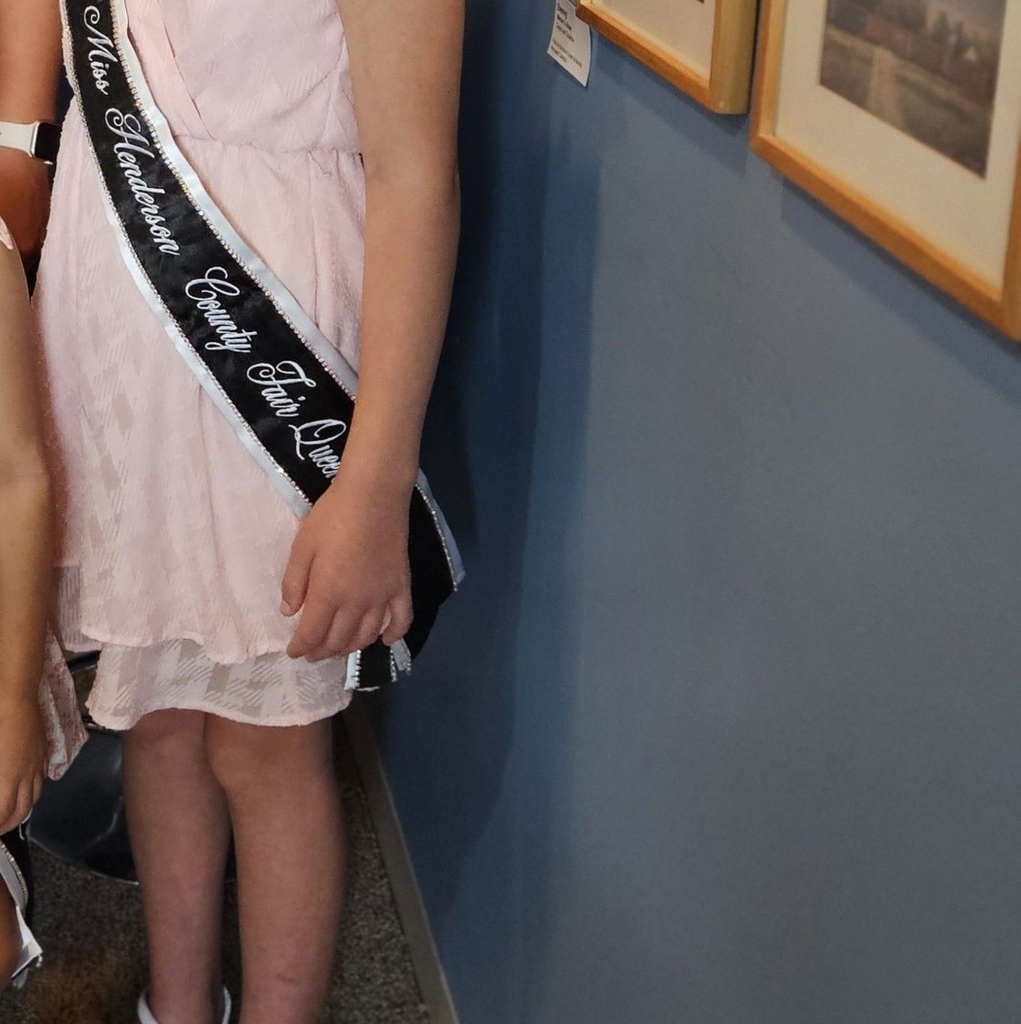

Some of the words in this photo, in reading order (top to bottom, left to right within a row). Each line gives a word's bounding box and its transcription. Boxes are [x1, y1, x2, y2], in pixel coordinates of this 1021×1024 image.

[83, 5, 119, 95] Miss
[105, 107, 181, 257] Henderson
[184, 265, 258, 354] County
[246, 360, 317, 418] Fair
